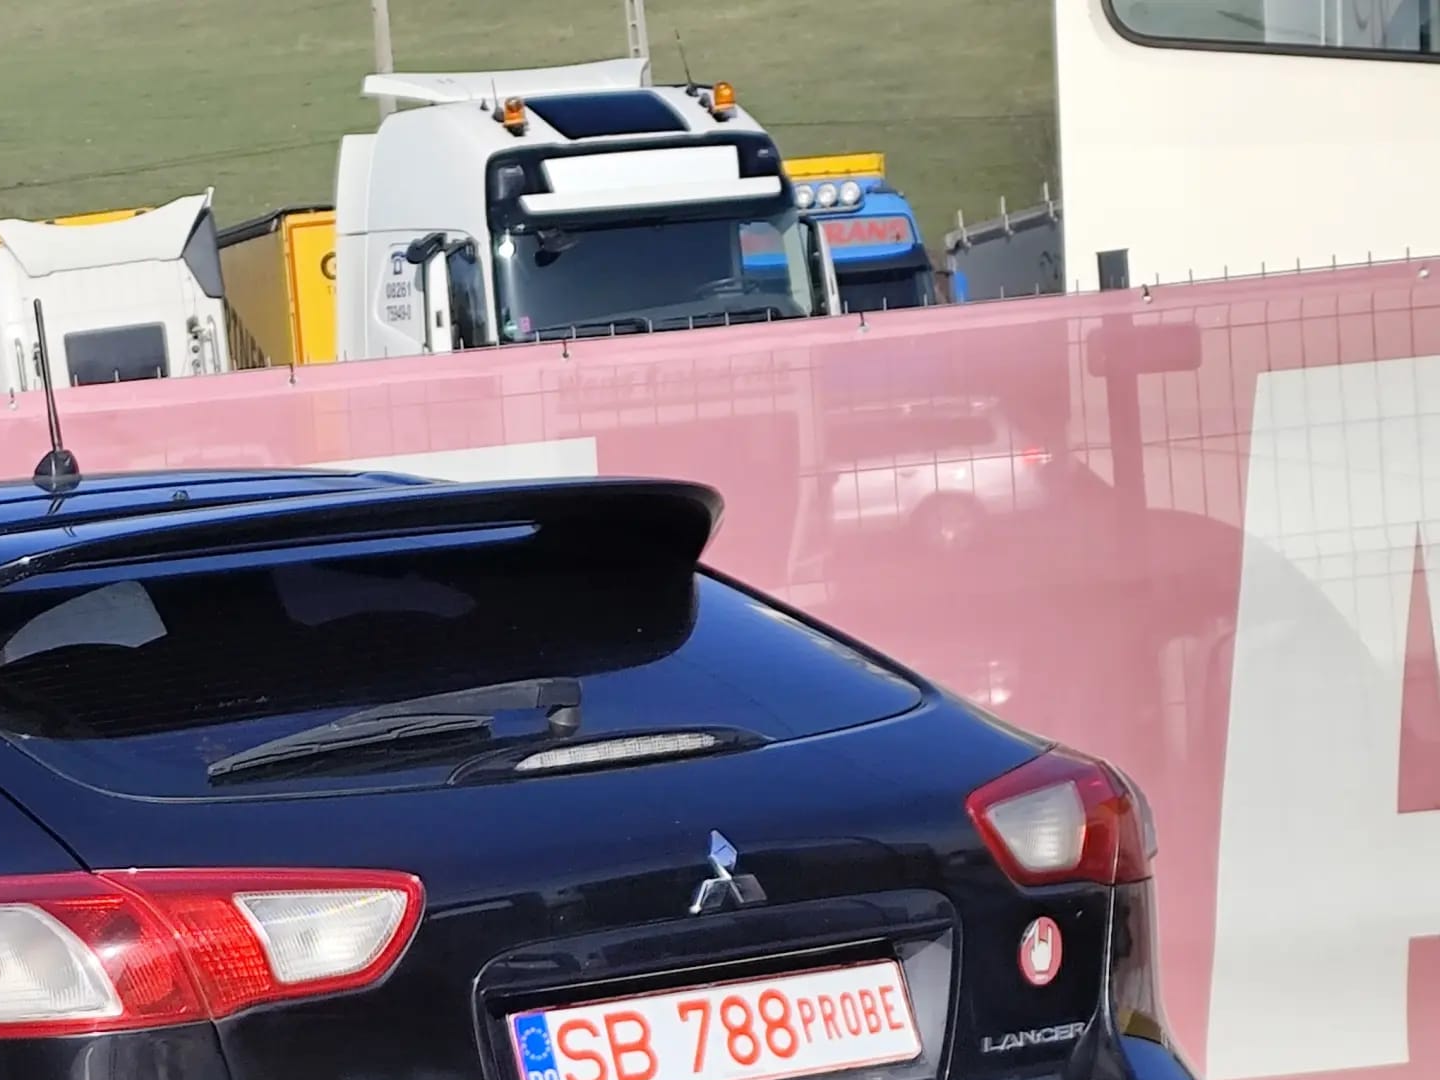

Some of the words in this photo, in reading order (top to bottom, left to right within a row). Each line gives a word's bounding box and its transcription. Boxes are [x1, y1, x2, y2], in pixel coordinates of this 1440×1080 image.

[677, 988, 800, 1074] 788
[796, 984, 905, 1043] PROBE
[981, 1021, 1085, 1052] LANCER
